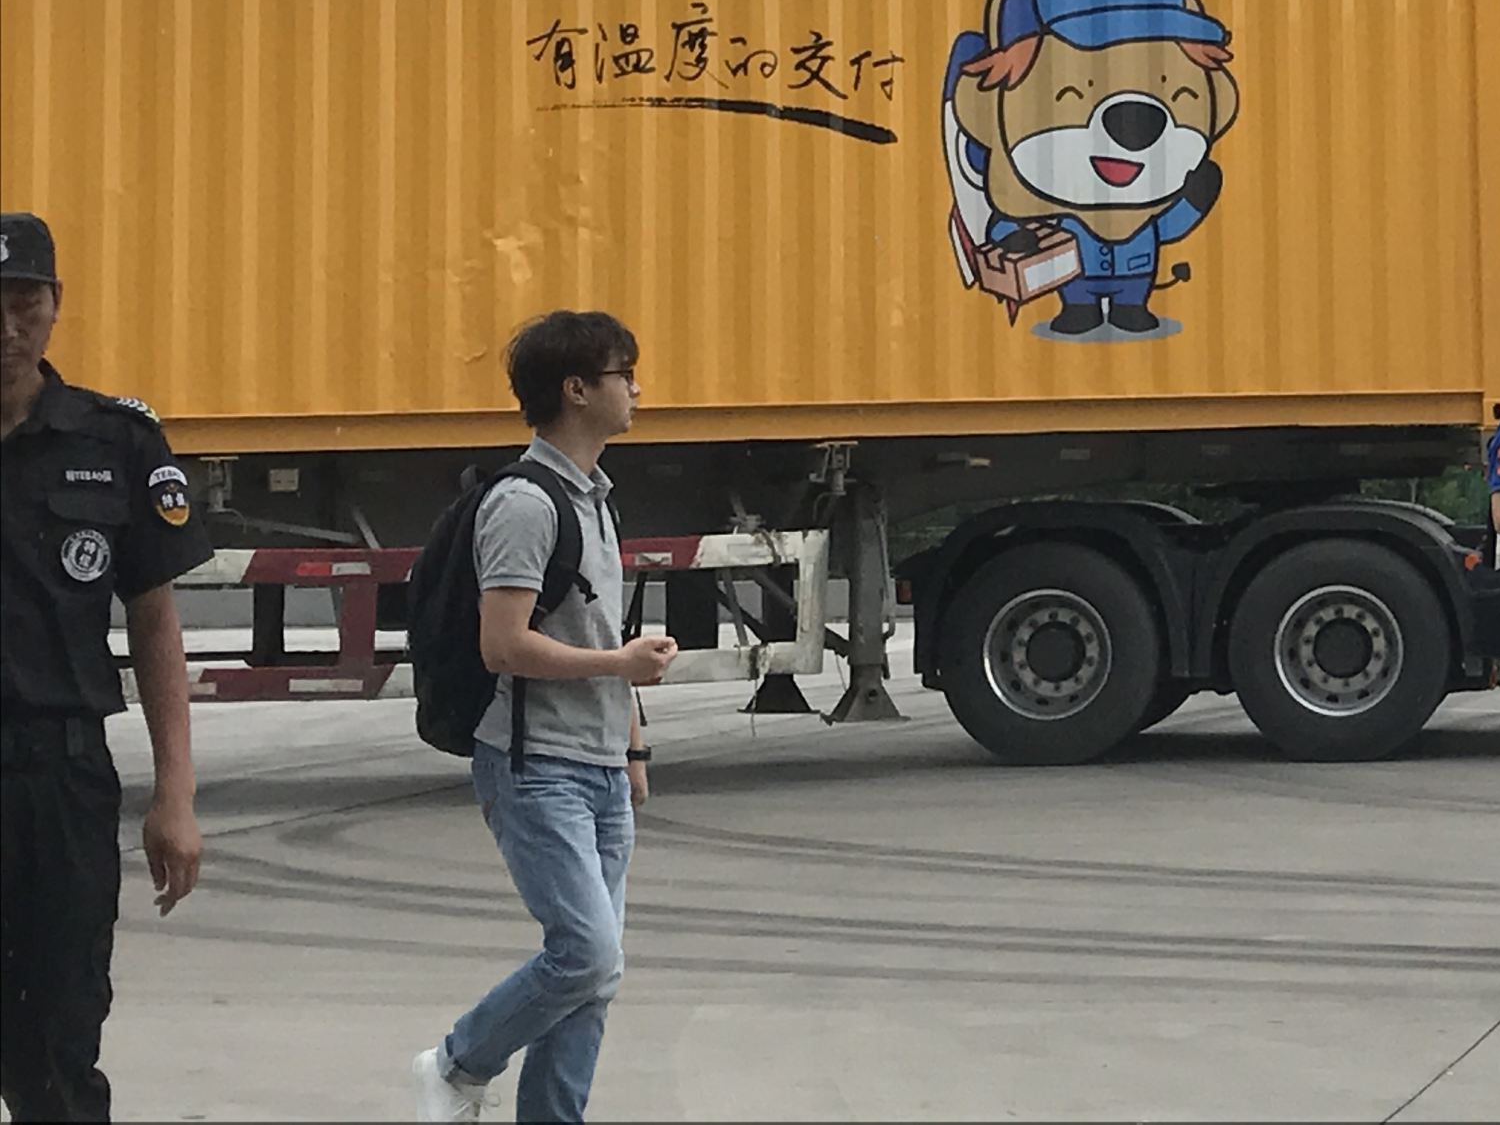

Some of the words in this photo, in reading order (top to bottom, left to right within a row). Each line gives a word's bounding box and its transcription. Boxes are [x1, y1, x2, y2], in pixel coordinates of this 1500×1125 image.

[526, 2, 906, 101] 有温度的交付
